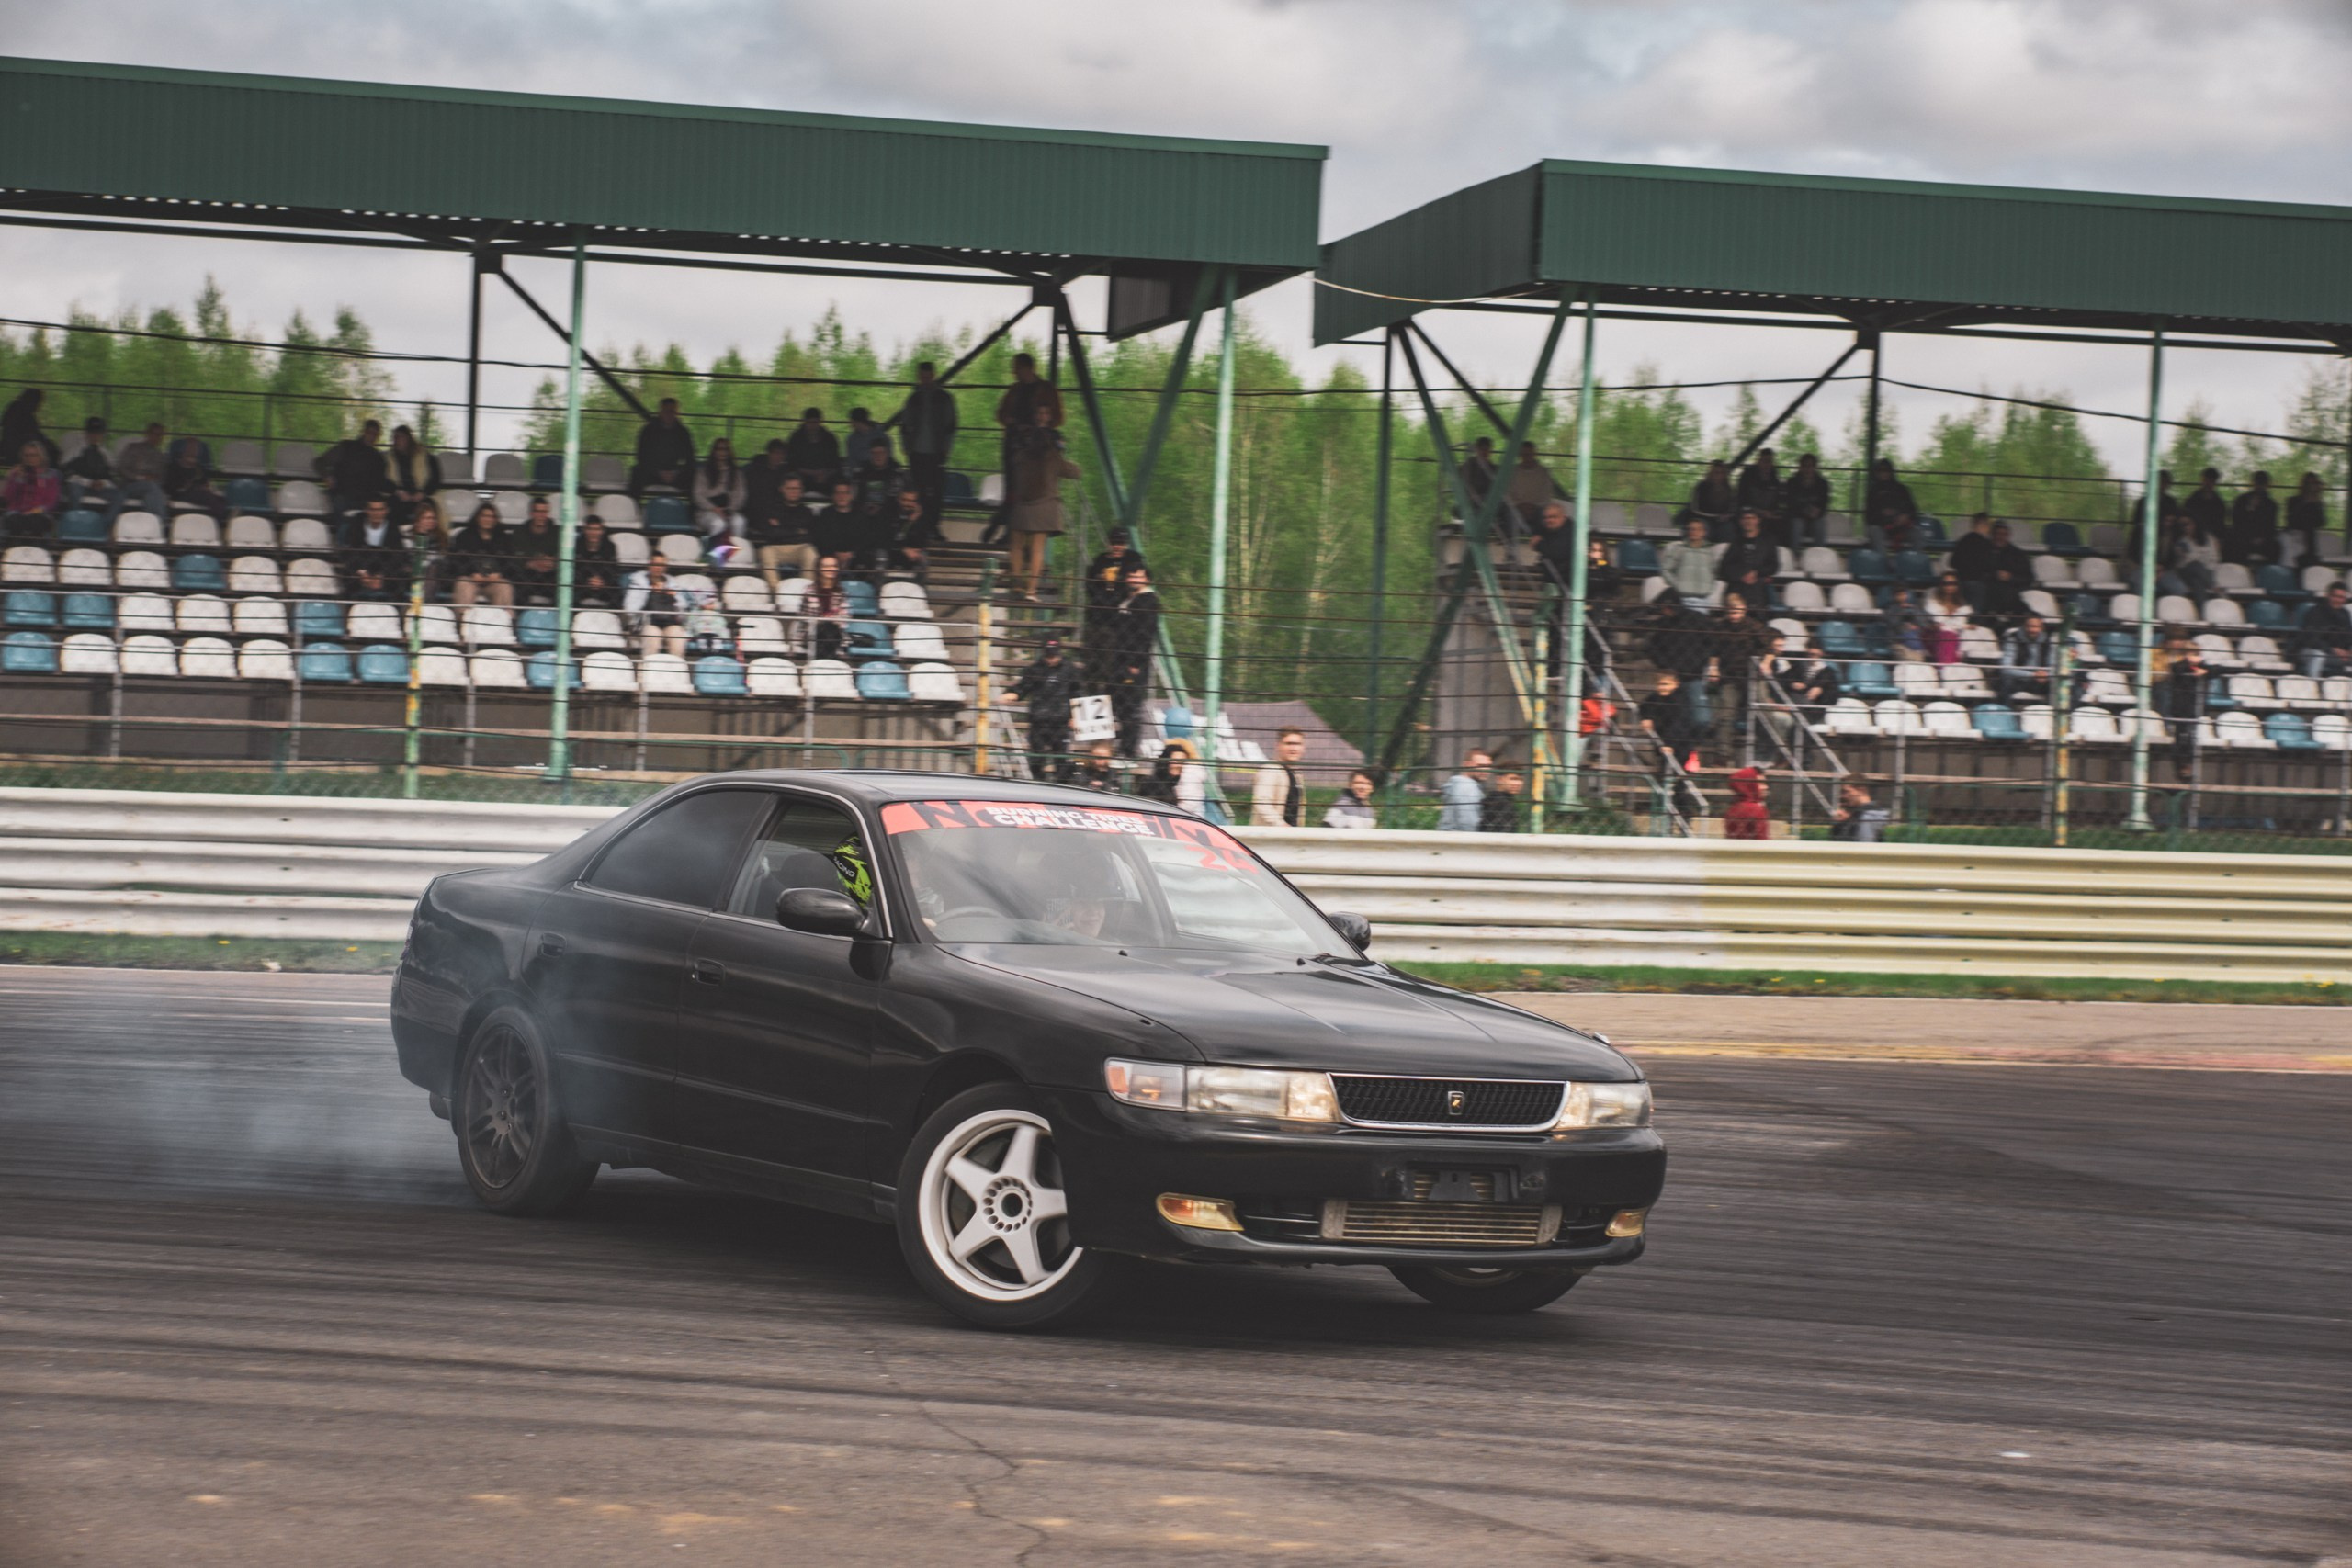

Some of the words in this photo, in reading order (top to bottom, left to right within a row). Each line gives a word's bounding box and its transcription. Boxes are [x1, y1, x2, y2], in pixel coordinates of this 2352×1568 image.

[1071, 698, 1106, 721] 12
[985, 807, 1083, 819] BURNING
[1084, 812, 1144, 825] TIRES
[993, 814, 1156, 836] CHALLENGE
